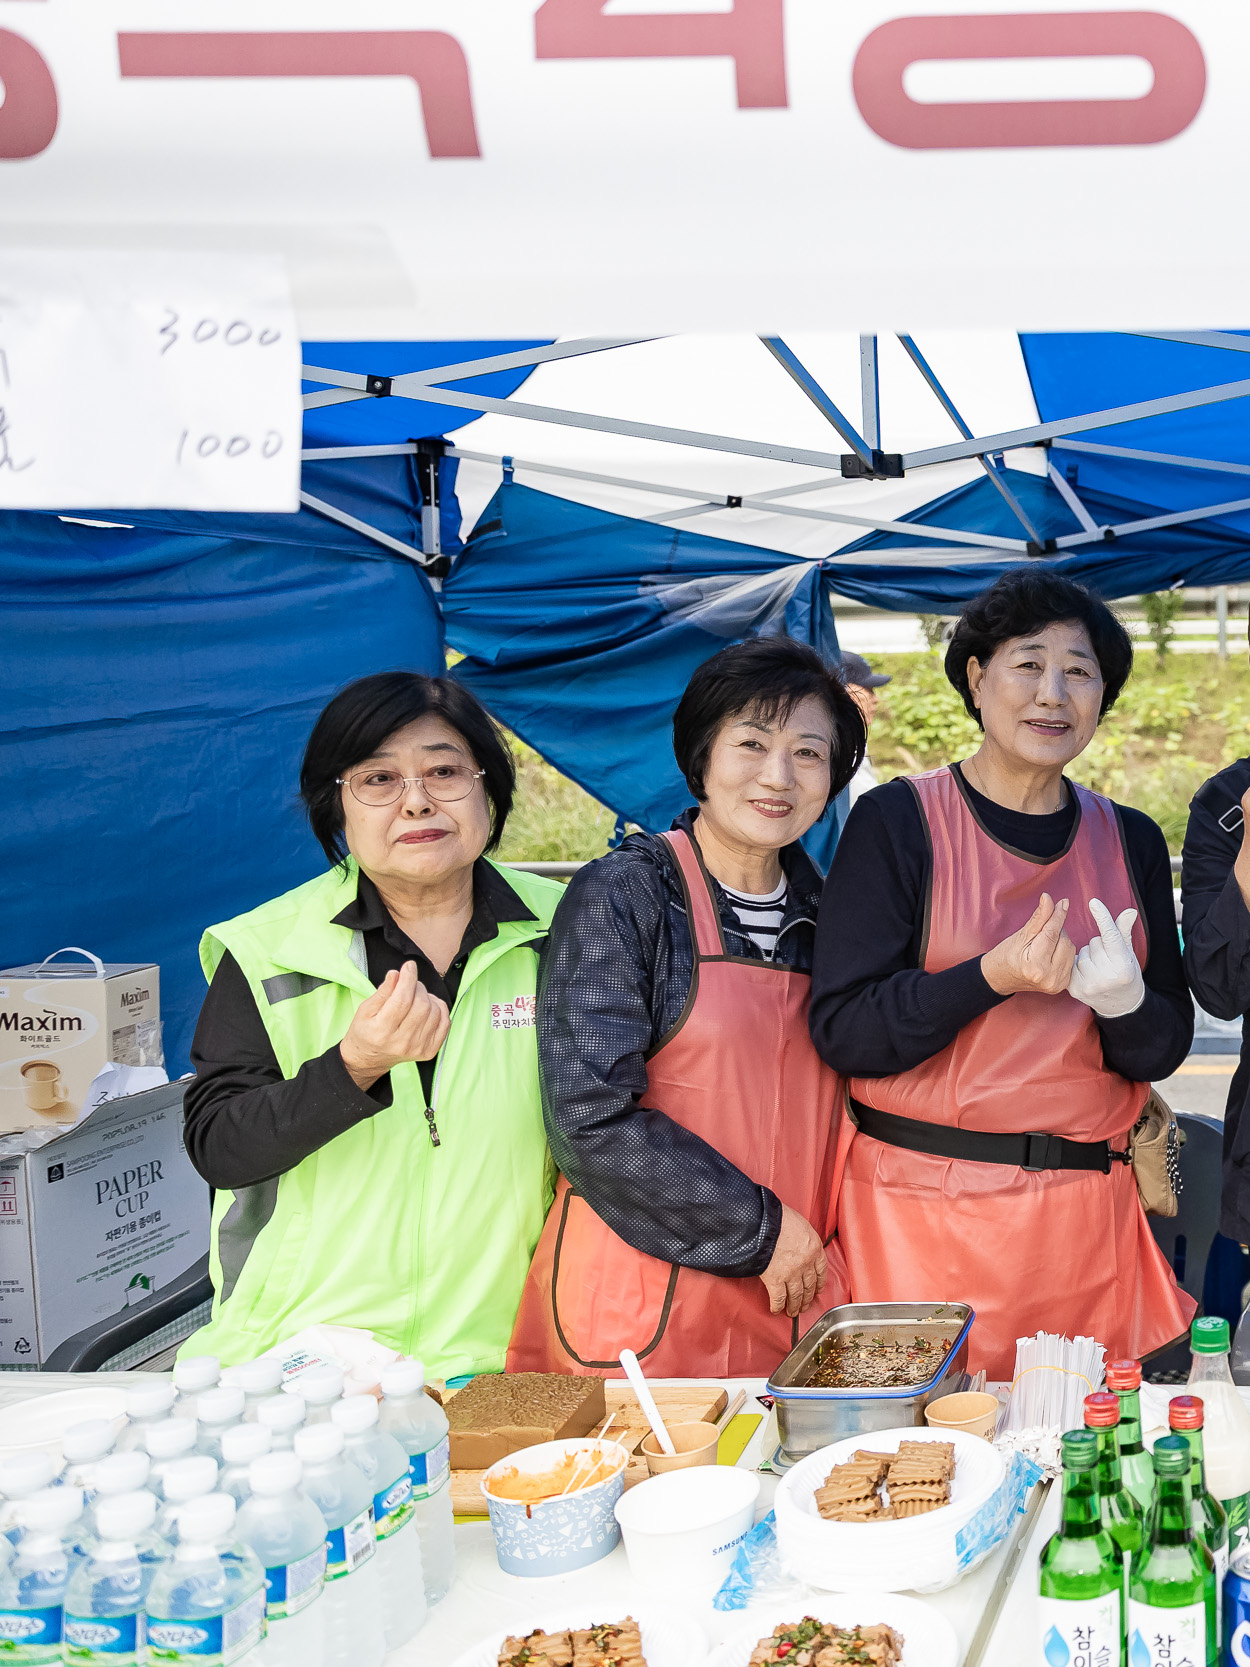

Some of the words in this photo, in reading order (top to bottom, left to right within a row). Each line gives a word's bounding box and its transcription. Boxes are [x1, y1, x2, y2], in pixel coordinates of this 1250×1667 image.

[158, 307, 282, 356] 3000
[176, 429, 283, 465] 1000
[120, 987, 150, 1008] Maxim
[0, 1009, 82, 1031] Maxim
[20, 1035, 61, 1043] 화이트골드
[95, 1160, 164, 1205] PAPER
[115, 1190, 149, 1218] CUP
